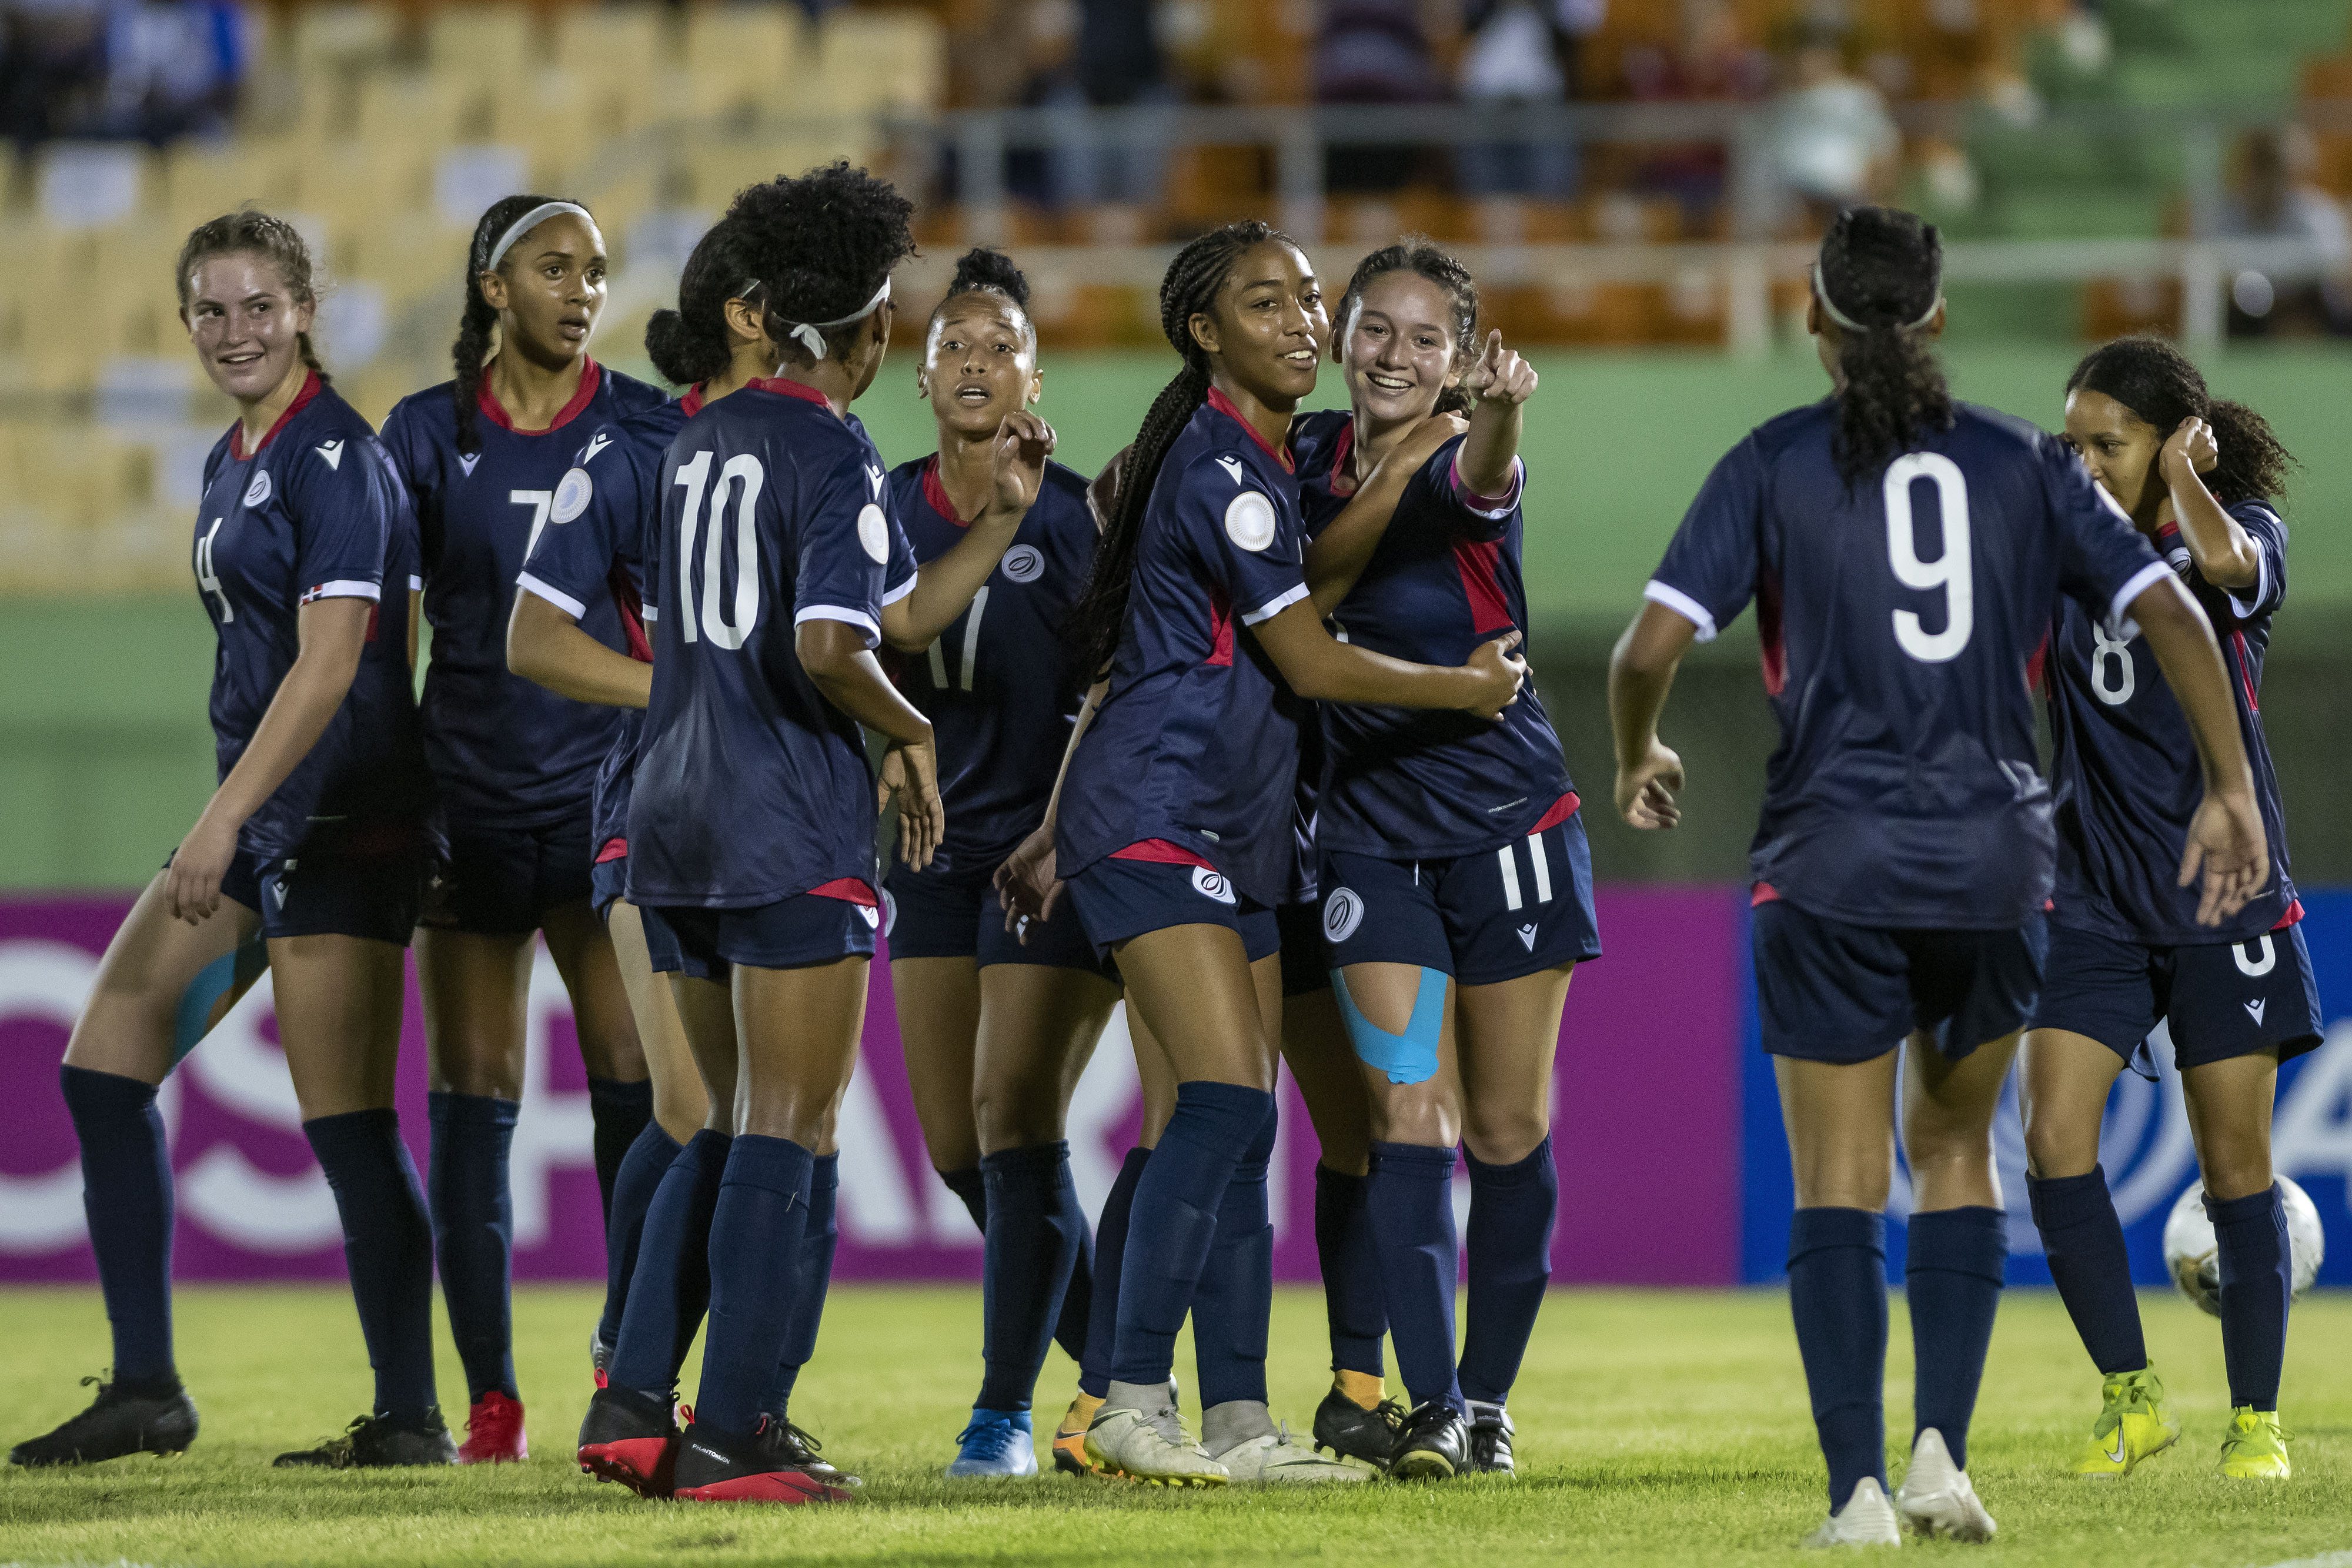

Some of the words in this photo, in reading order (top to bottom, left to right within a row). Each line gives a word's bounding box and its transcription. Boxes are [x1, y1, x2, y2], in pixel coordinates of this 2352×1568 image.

[197, 517, 234, 623] 4
[510, 490, 553, 566] 7
[675, 451, 764, 650] 10
[1883, 451, 1974, 663] 9
[2092, 619, 2135, 706] 8
